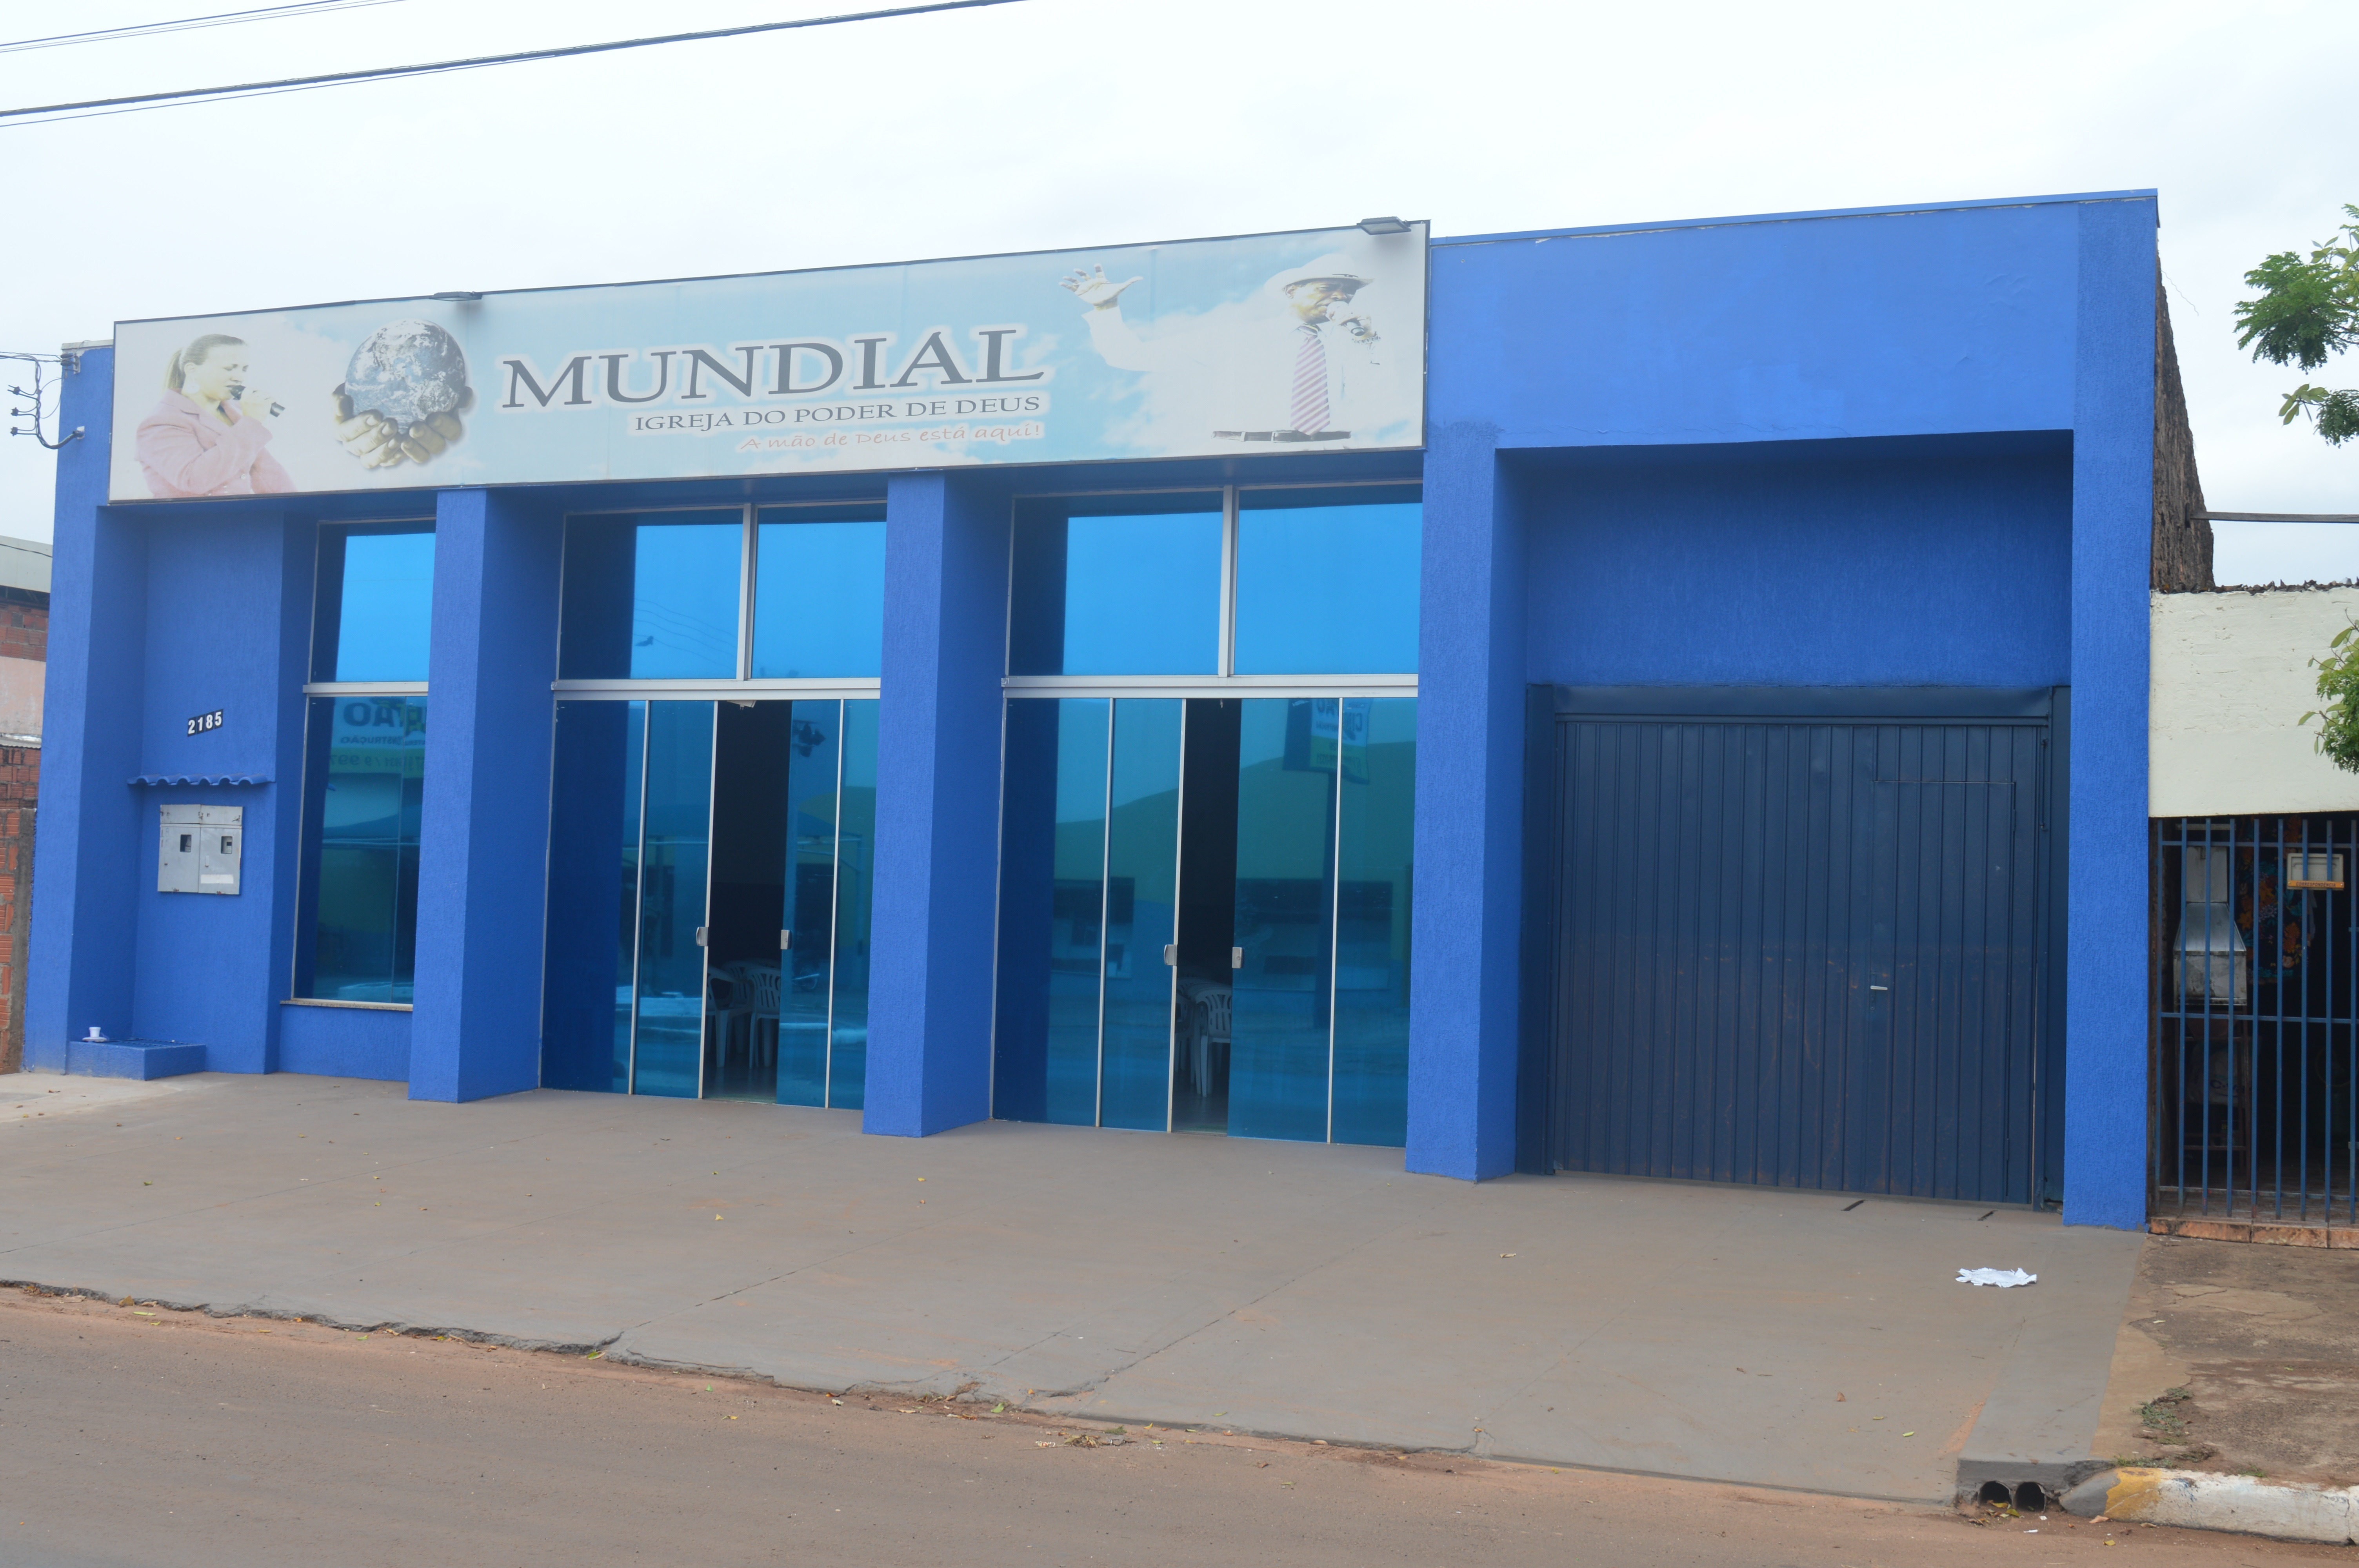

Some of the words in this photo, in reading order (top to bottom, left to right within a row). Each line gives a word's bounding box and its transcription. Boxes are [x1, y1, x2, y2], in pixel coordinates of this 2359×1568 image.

[502, 330, 1044, 408] MUNDIAL
[635, 412, 734, 432] IGREJA
[743, 410, 786, 425] DO
[794, 404, 898, 423] PODER
[905, 401, 947, 417] DE
[955, 396, 1040, 414] DEUS
[740, 438, 761, 450] A
[769, 435, 816, 448] mão
[824, 432, 848, 446] de
[855, 432, 911, 444] Deus
[920, 426, 965, 441] está
[188, 711, 222, 734] 2185
